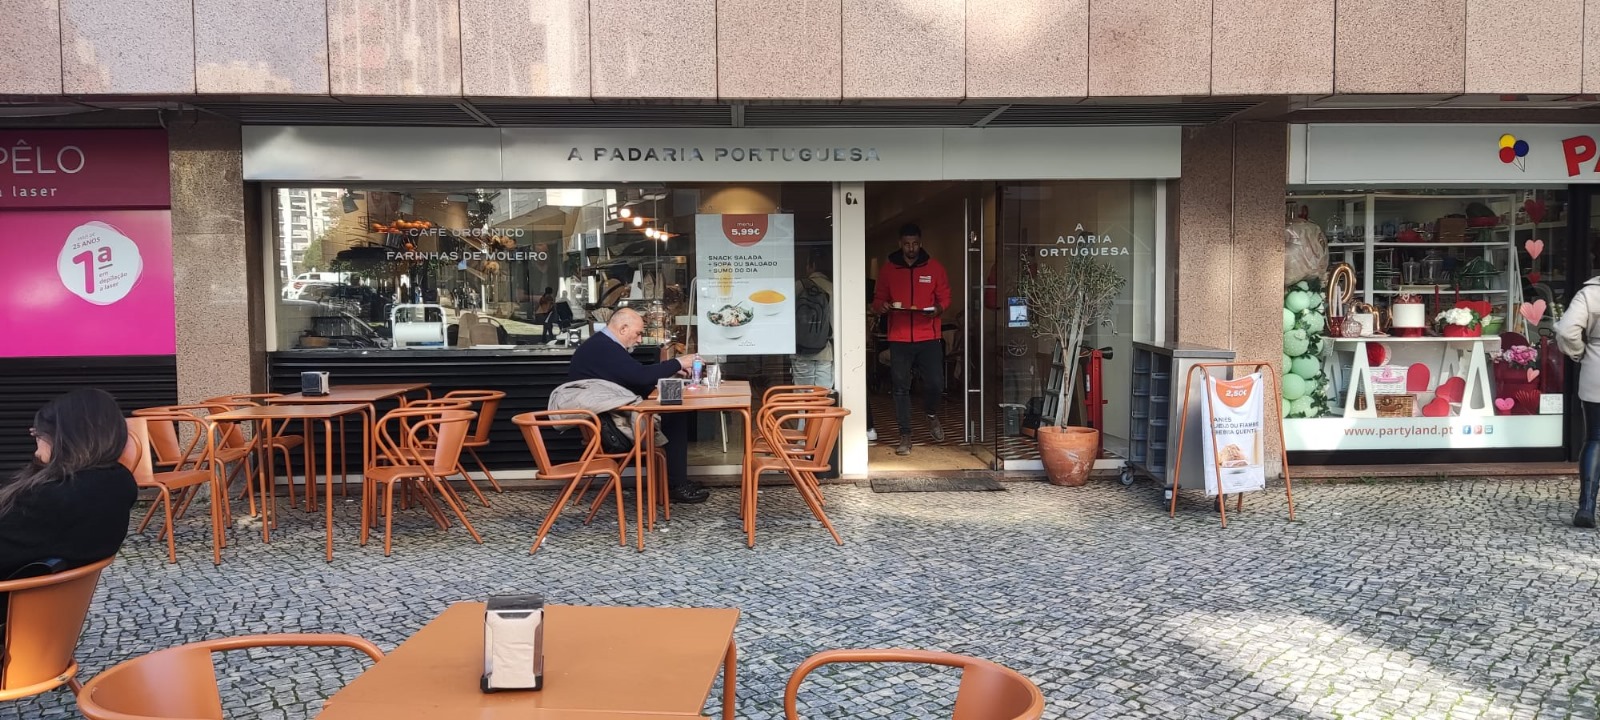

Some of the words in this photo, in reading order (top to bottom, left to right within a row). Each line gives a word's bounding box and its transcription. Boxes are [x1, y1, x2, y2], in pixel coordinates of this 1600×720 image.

[567, 147, 583, 162] A
[593, 147, 704, 162] PADARIA
[714, 147, 881, 162] PORTUGUESA
[1562, 135, 1600, 178] P
[12, 185, 57, 197] laser
[731, 228, 760, 236] 5,99€
[1075, 223, 1084, 231] A
[82, 236, 101, 247] ANOS
[386, 251, 459, 261] FARINHAS
[462, 251, 483, 261] DE
[485, 251, 548, 261] MOLEIRO
[104, 282, 119, 290] laser
[1344, 425, 1454, 439] www.partyland.pt
